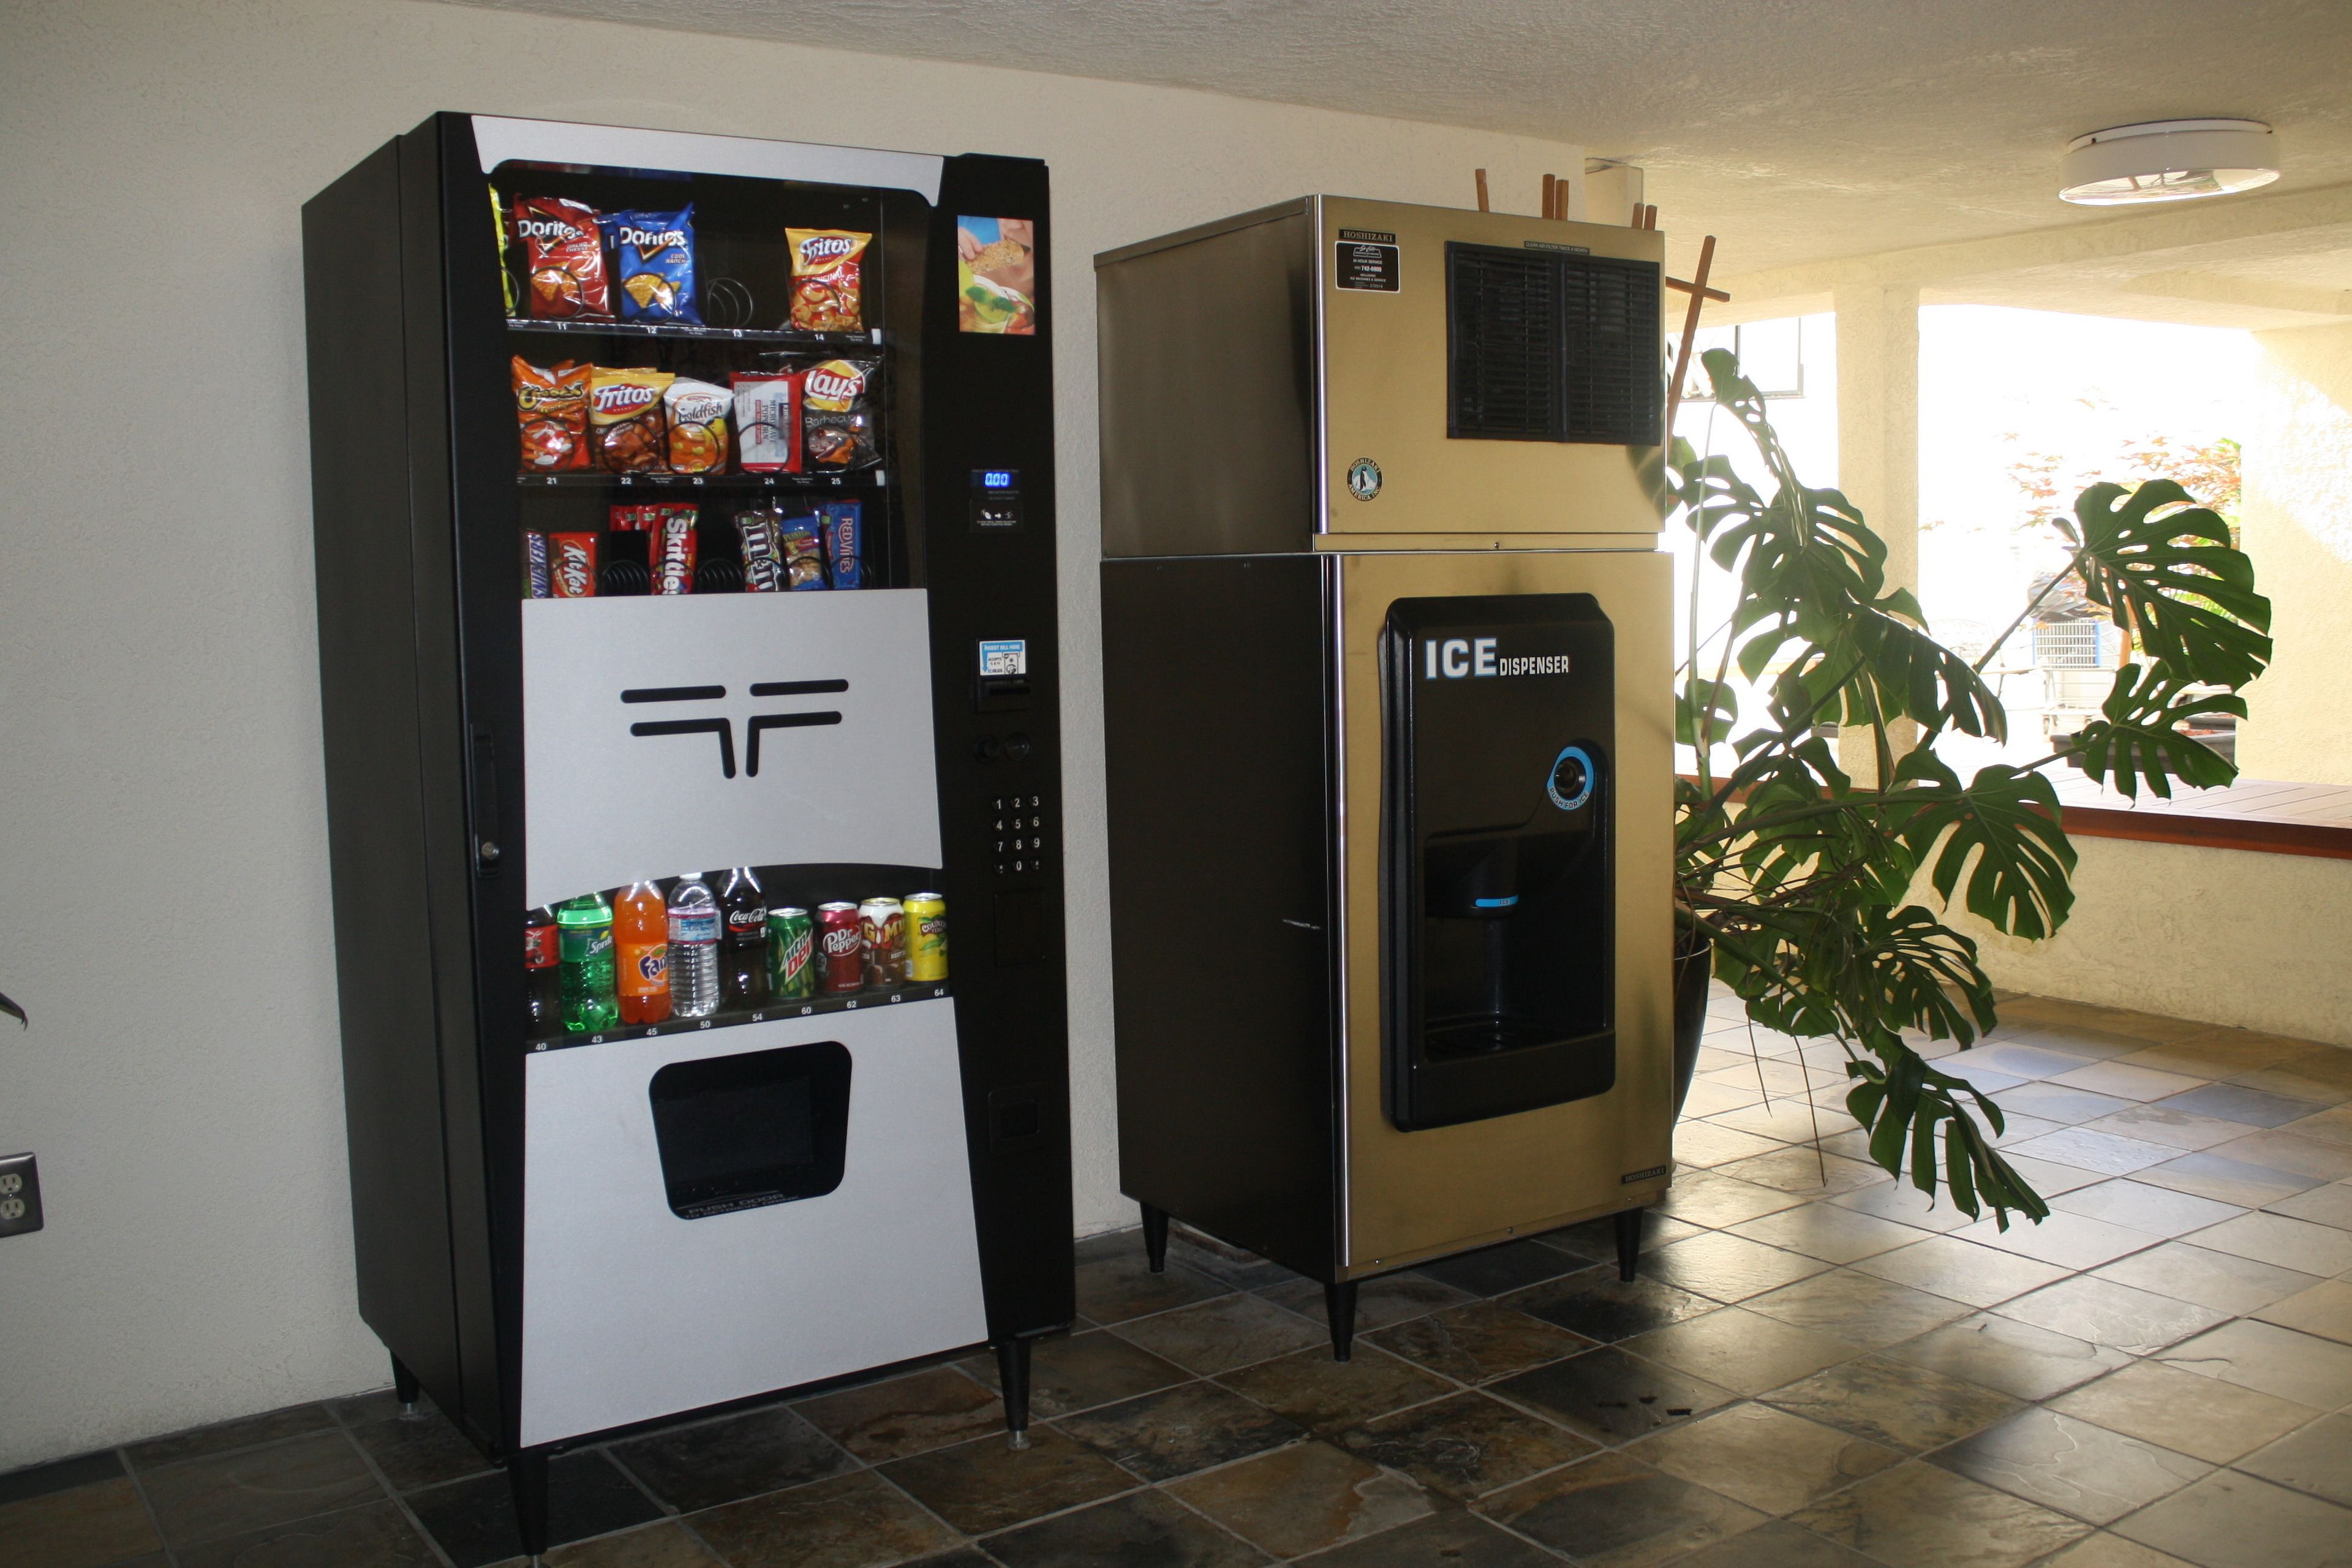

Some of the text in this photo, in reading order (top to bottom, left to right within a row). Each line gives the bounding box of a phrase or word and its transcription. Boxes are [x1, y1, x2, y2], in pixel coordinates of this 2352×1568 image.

[620, 227, 687, 245] Doritos
[1343, 231, 1393, 243] HOSHIZAKI
[799, 237, 852, 266] Fritos
[594, 383, 655, 412] Fritos
[805, 415, 856, 428] Barbecu
[1350, 458, 1381, 473] HOSHIZAKI
[984, 473, 1009, 486] 0.00
[839, 518, 853, 541] RED
[530, 534, 546, 598] SNICKERS
[1425, 638, 1569, 679] ICE DISPENSER
[1032, 796, 1039, 807] 3
[1549, 787, 1563, 806] PUSH
[1579, 791, 1589, 804] ICE
[996, 799, 1001, 809] 1
[1014, 797, 1020, 808] 2
[996, 820, 1003, 831] 4
[1015, 819, 1021, 829] 5
[1033, 816, 1039, 827] 6
[998, 842, 1004, 852] 7
[1016, 839, 1022, 850] 8
[1033, 837, 1040, 848] 9
[1016, 861, 1022, 871] 0
[837, 929, 853, 938] Dr
[884, 919, 905, 943] MU
[589, 935, 612, 954] Sprit
[827, 932, 859, 954] Pepper
[638, 956, 666, 981] Fan
[934, 989, 944, 997] 64
[846, 1000, 857, 1009] 62
[891, 995, 901, 1003] 63
[801, 1006, 812, 1015] 60
[752, 1013, 763, 1022] 54
[700, 1020, 710, 1029] 50
[592, 1035, 603, 1044] 43
[535, 1042, 546, 1051] 40
[1624, 1167, 1664, 1183] HOSHIZAKI
[688, 1194, 784, 1214] PUSH DOOR
